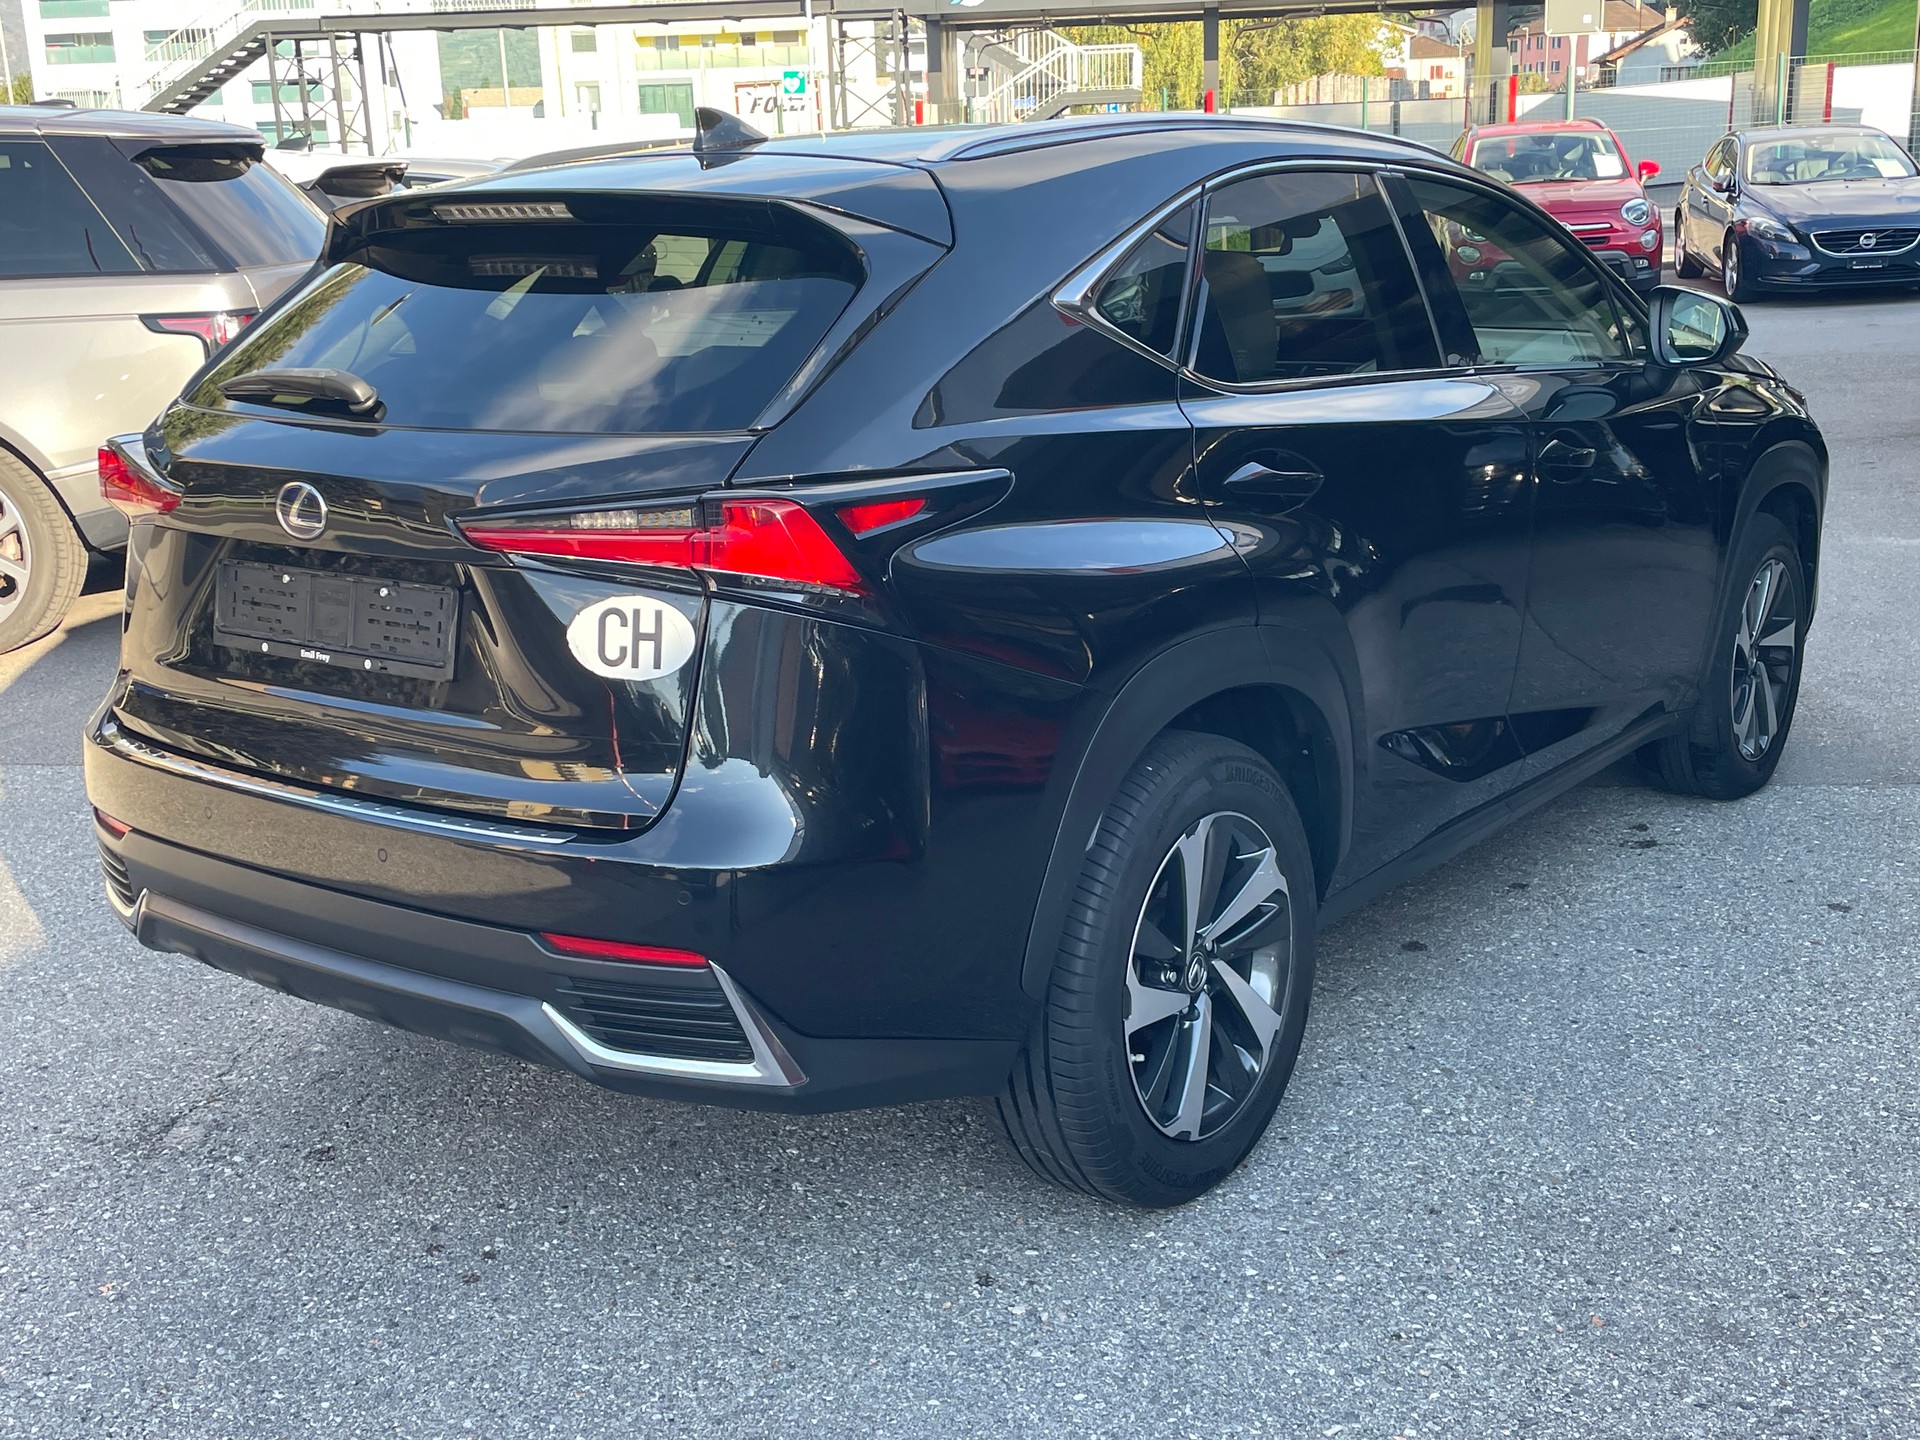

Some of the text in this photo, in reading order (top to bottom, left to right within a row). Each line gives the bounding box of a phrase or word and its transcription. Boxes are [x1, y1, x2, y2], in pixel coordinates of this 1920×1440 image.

[300, 649, 331, 664] Emil Frey
[597, 607, 663, 670] CH
